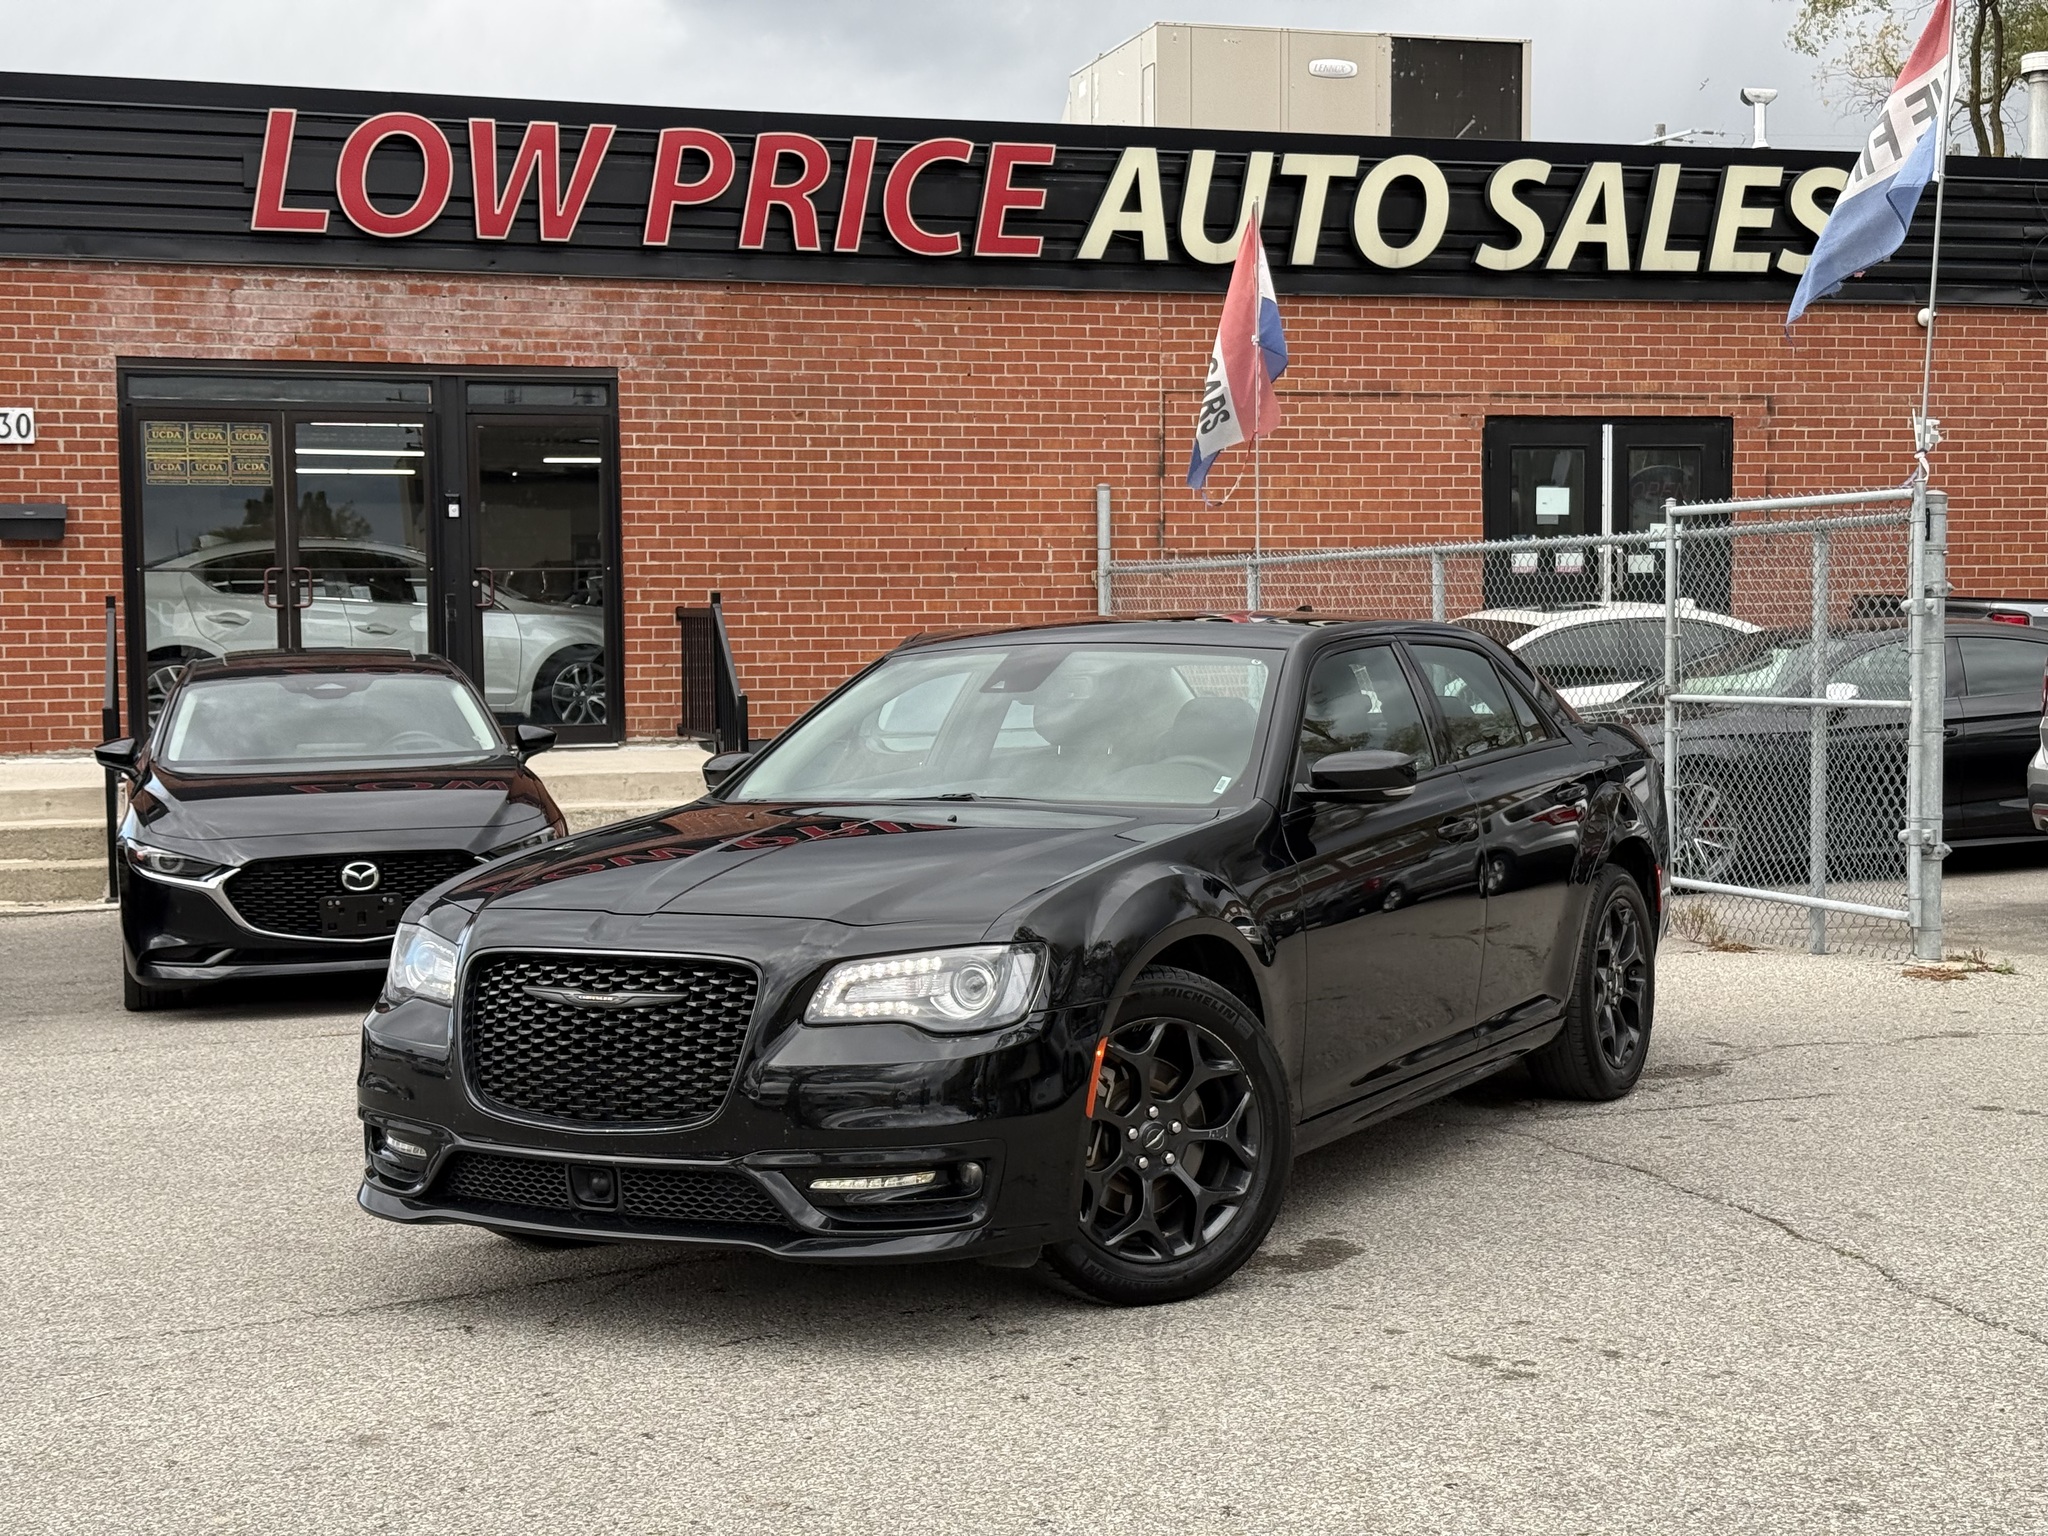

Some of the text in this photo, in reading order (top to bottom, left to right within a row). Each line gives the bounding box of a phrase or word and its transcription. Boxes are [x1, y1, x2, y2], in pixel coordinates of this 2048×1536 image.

[250, 107, 1850, 275] LOW PRICE AUTO SALES
[0, 412, 32, 439] 30
[152, 430, 181, 439] UCDA
[193, 431, 223, 440] UCDA
[235, 432, 264, 441] UCDA
[153, 463, 182, 471] UCDA
[195, 463, 224, 471] UCDA
[236, 462, 266, 471] UCDA
[1632, 481, 1691, 501] OPEN
[1164, 988, 1237, 1021] MICHELIN
